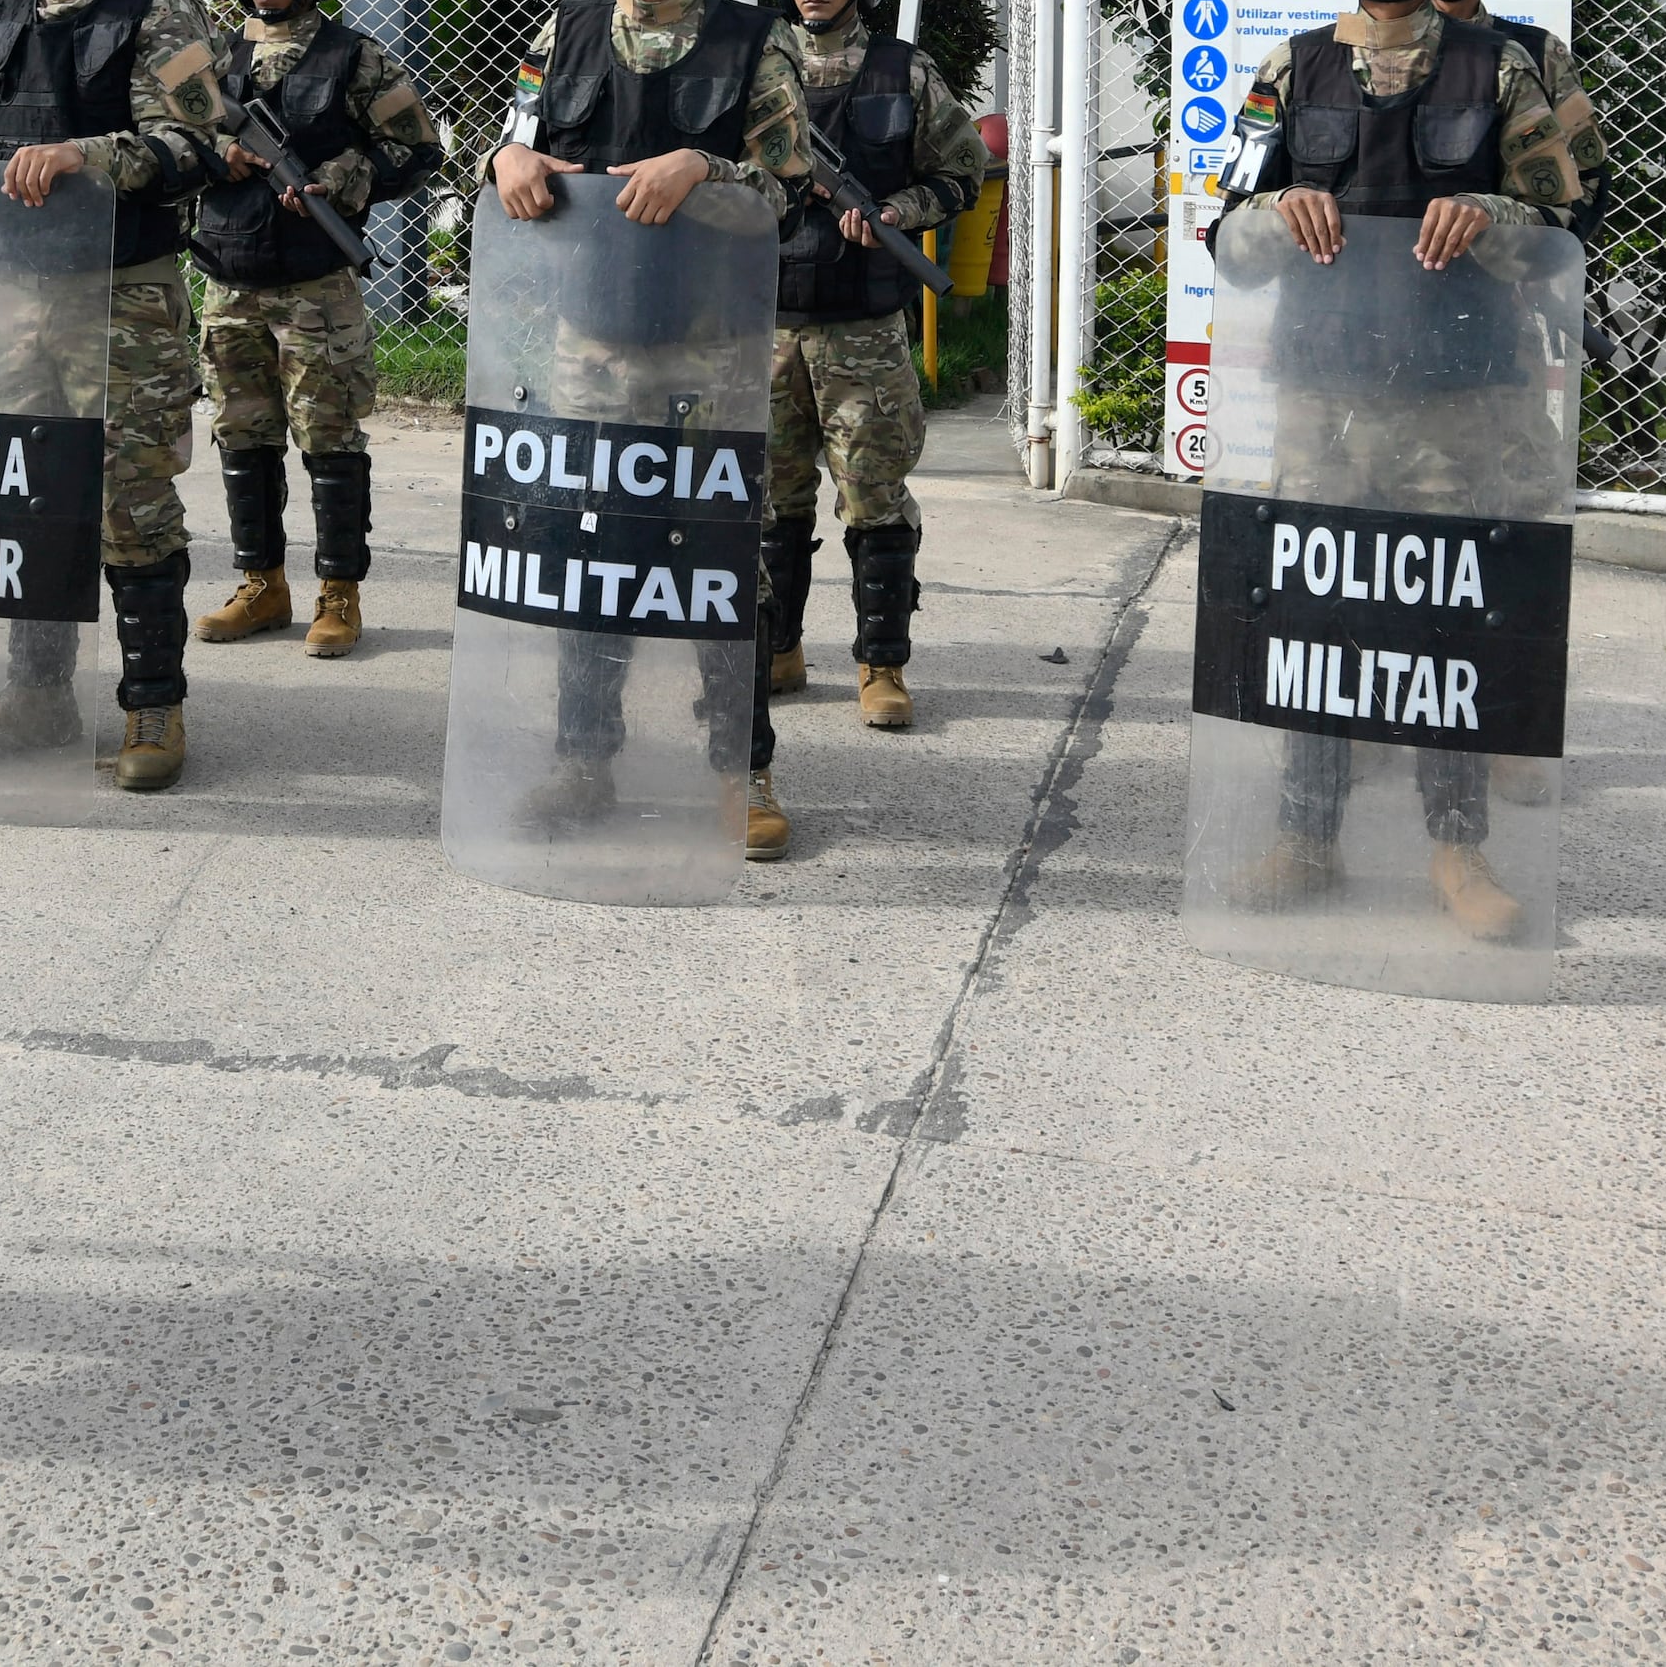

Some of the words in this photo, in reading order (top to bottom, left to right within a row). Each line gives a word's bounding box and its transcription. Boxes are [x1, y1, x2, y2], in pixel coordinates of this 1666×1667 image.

[1236, 8, 1283, 20] Utilizar
[1236, 25, 1289, 36] valvulas
[1217, 133, 1268, 193] PM
[1193, 380, 1206, 398] 5
[473, 421, 749, 504] POLICIA
[463, 540, 740, 625] MILITAR
[1271, 522, 1486, 609] POLICIA
[1265, 636, 1480, 731] MILITAR
